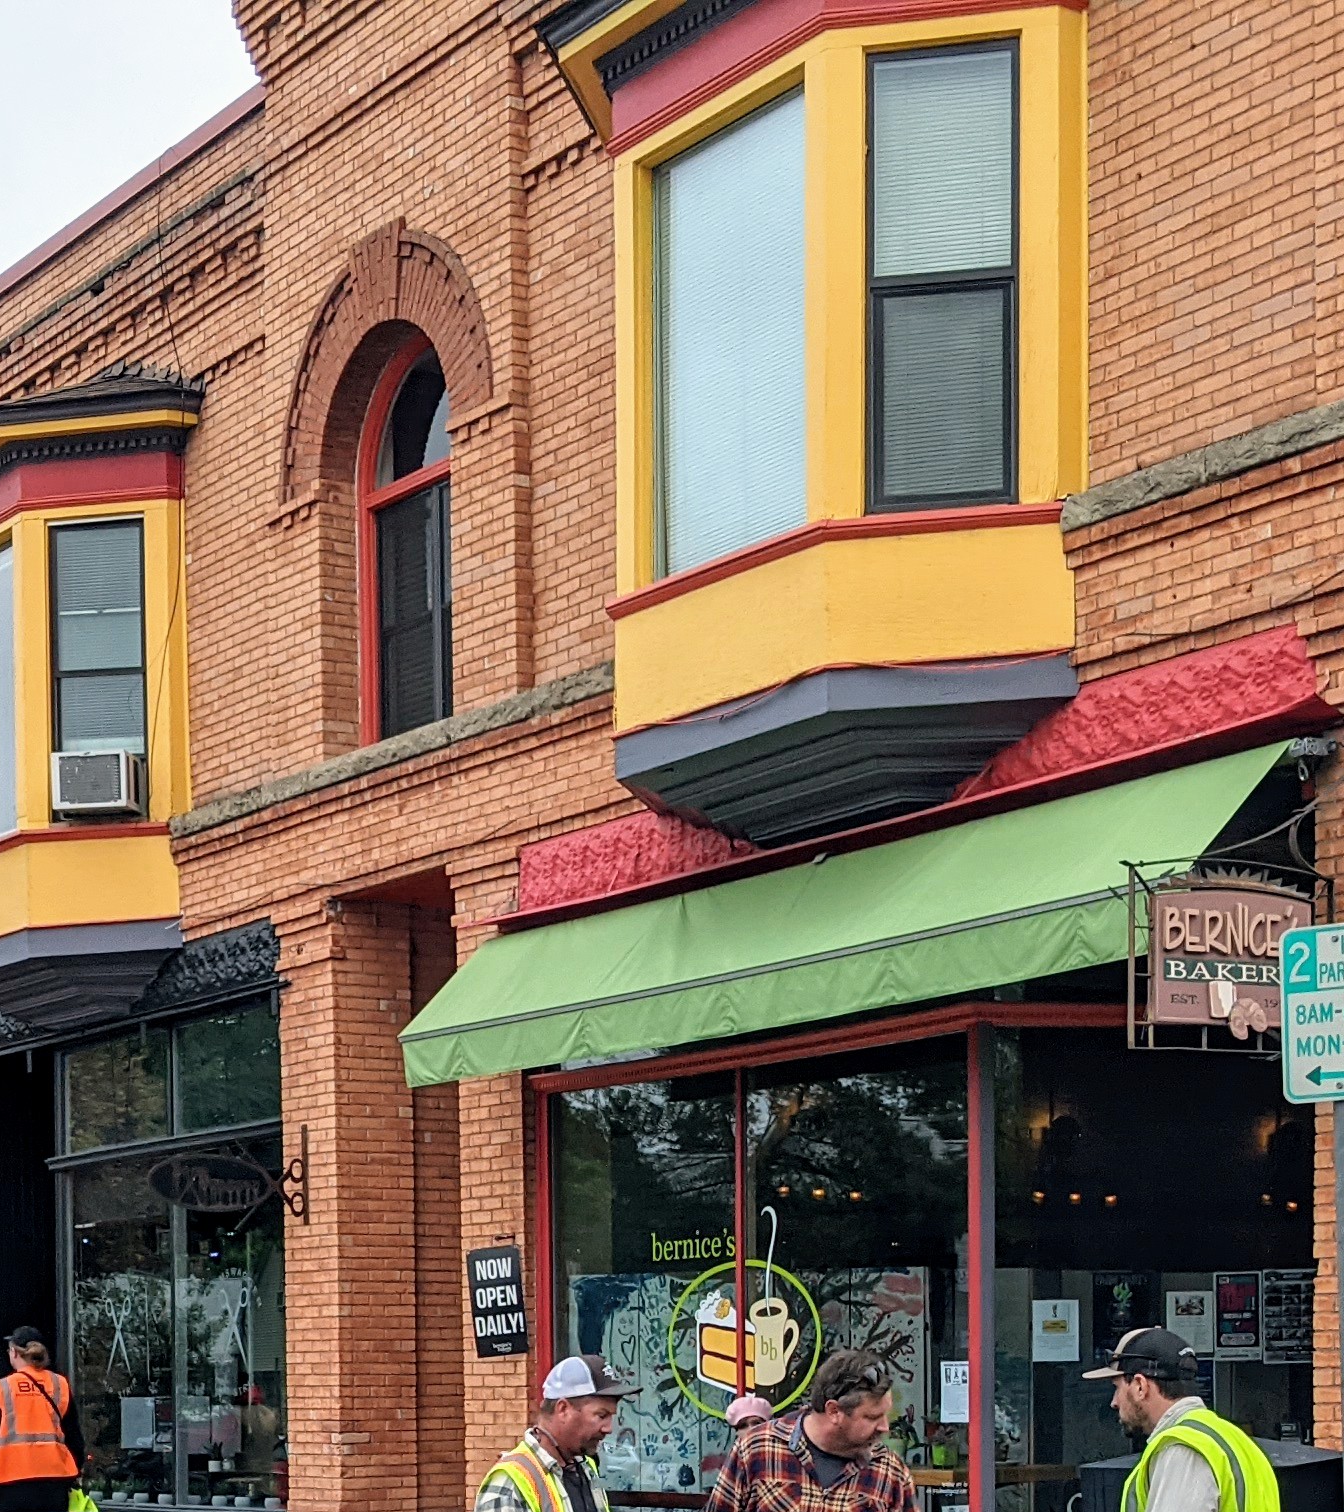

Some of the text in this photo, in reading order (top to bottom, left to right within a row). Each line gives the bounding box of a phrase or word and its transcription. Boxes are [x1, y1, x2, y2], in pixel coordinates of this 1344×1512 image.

[1166, 960, 1282, 984] BAKER
[1288, 941, 1311, 983] 2
[1169, 993, 1199, 1005] EST.
[650, 1228, 736, 1262] bernice's
[475, 1257, 512, 1282] NOW
[475, 1284, 518, 1309] OPEN
[474, 1311, 525, 1338] DAILY!
